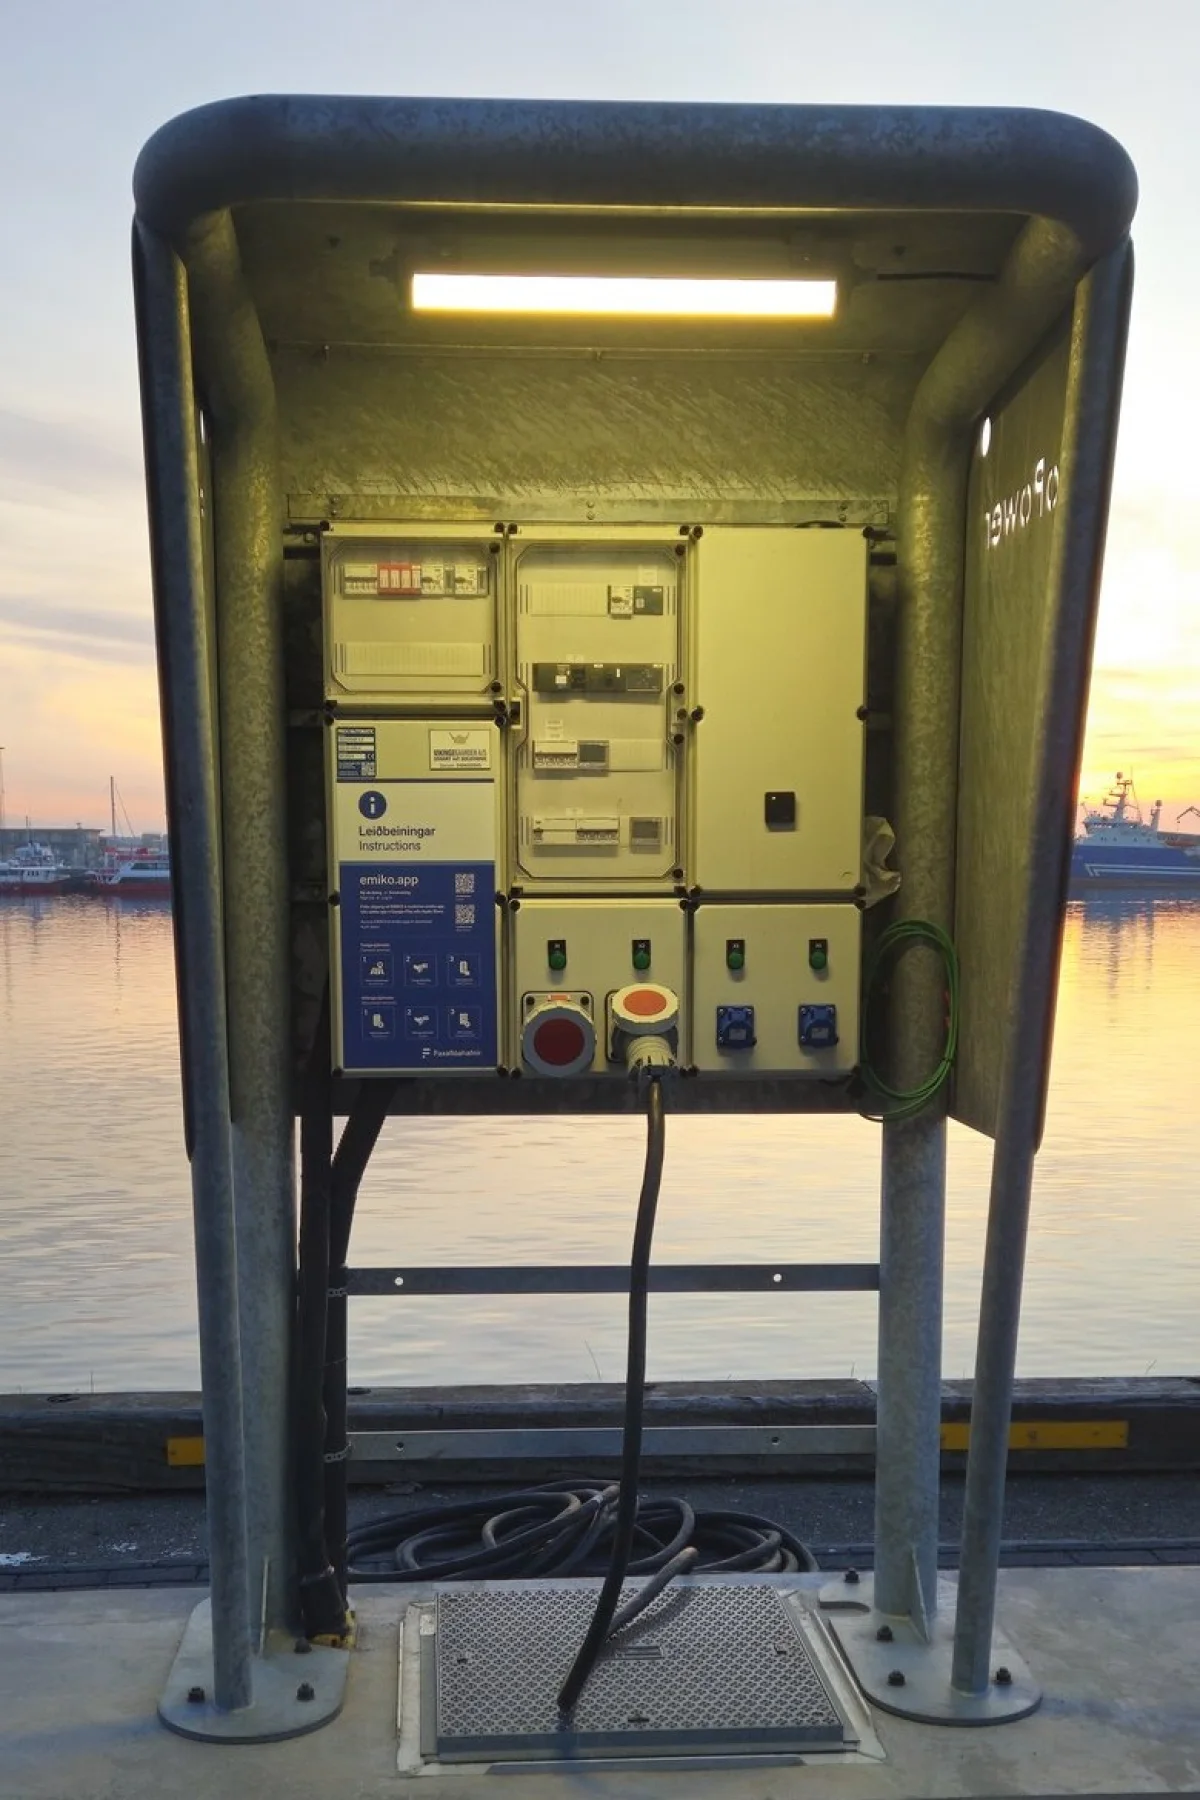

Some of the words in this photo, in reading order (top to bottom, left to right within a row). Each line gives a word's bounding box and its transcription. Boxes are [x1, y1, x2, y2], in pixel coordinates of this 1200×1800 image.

[359, 826, 436, 838] Leiðbeiningar
[360, 840, 421, 851] Instructions
[360, 874, 419, 887] emiko.app
